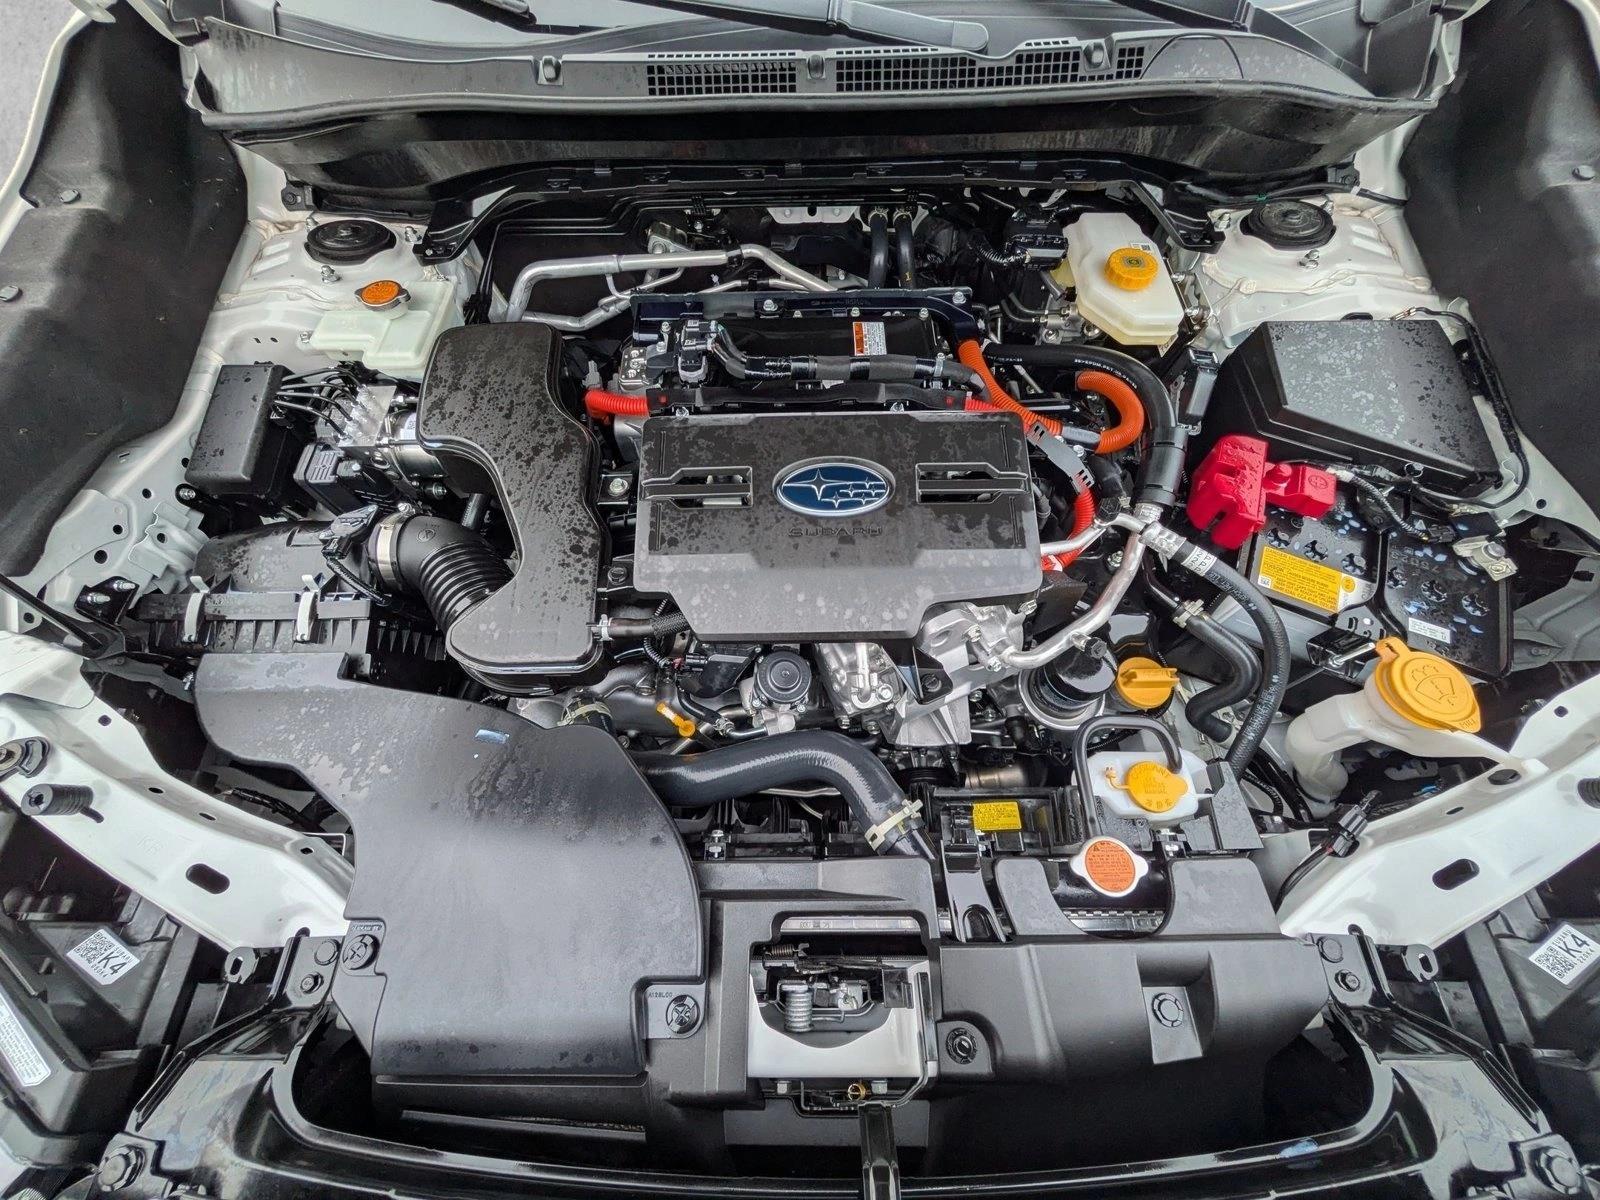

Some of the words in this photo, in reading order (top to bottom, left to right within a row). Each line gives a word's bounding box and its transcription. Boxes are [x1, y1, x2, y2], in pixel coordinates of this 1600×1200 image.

[789, 526, 882, 537] SUBARU
[1558, 934, 1590, 958] K4
[98, 951, 127, 975] K4
